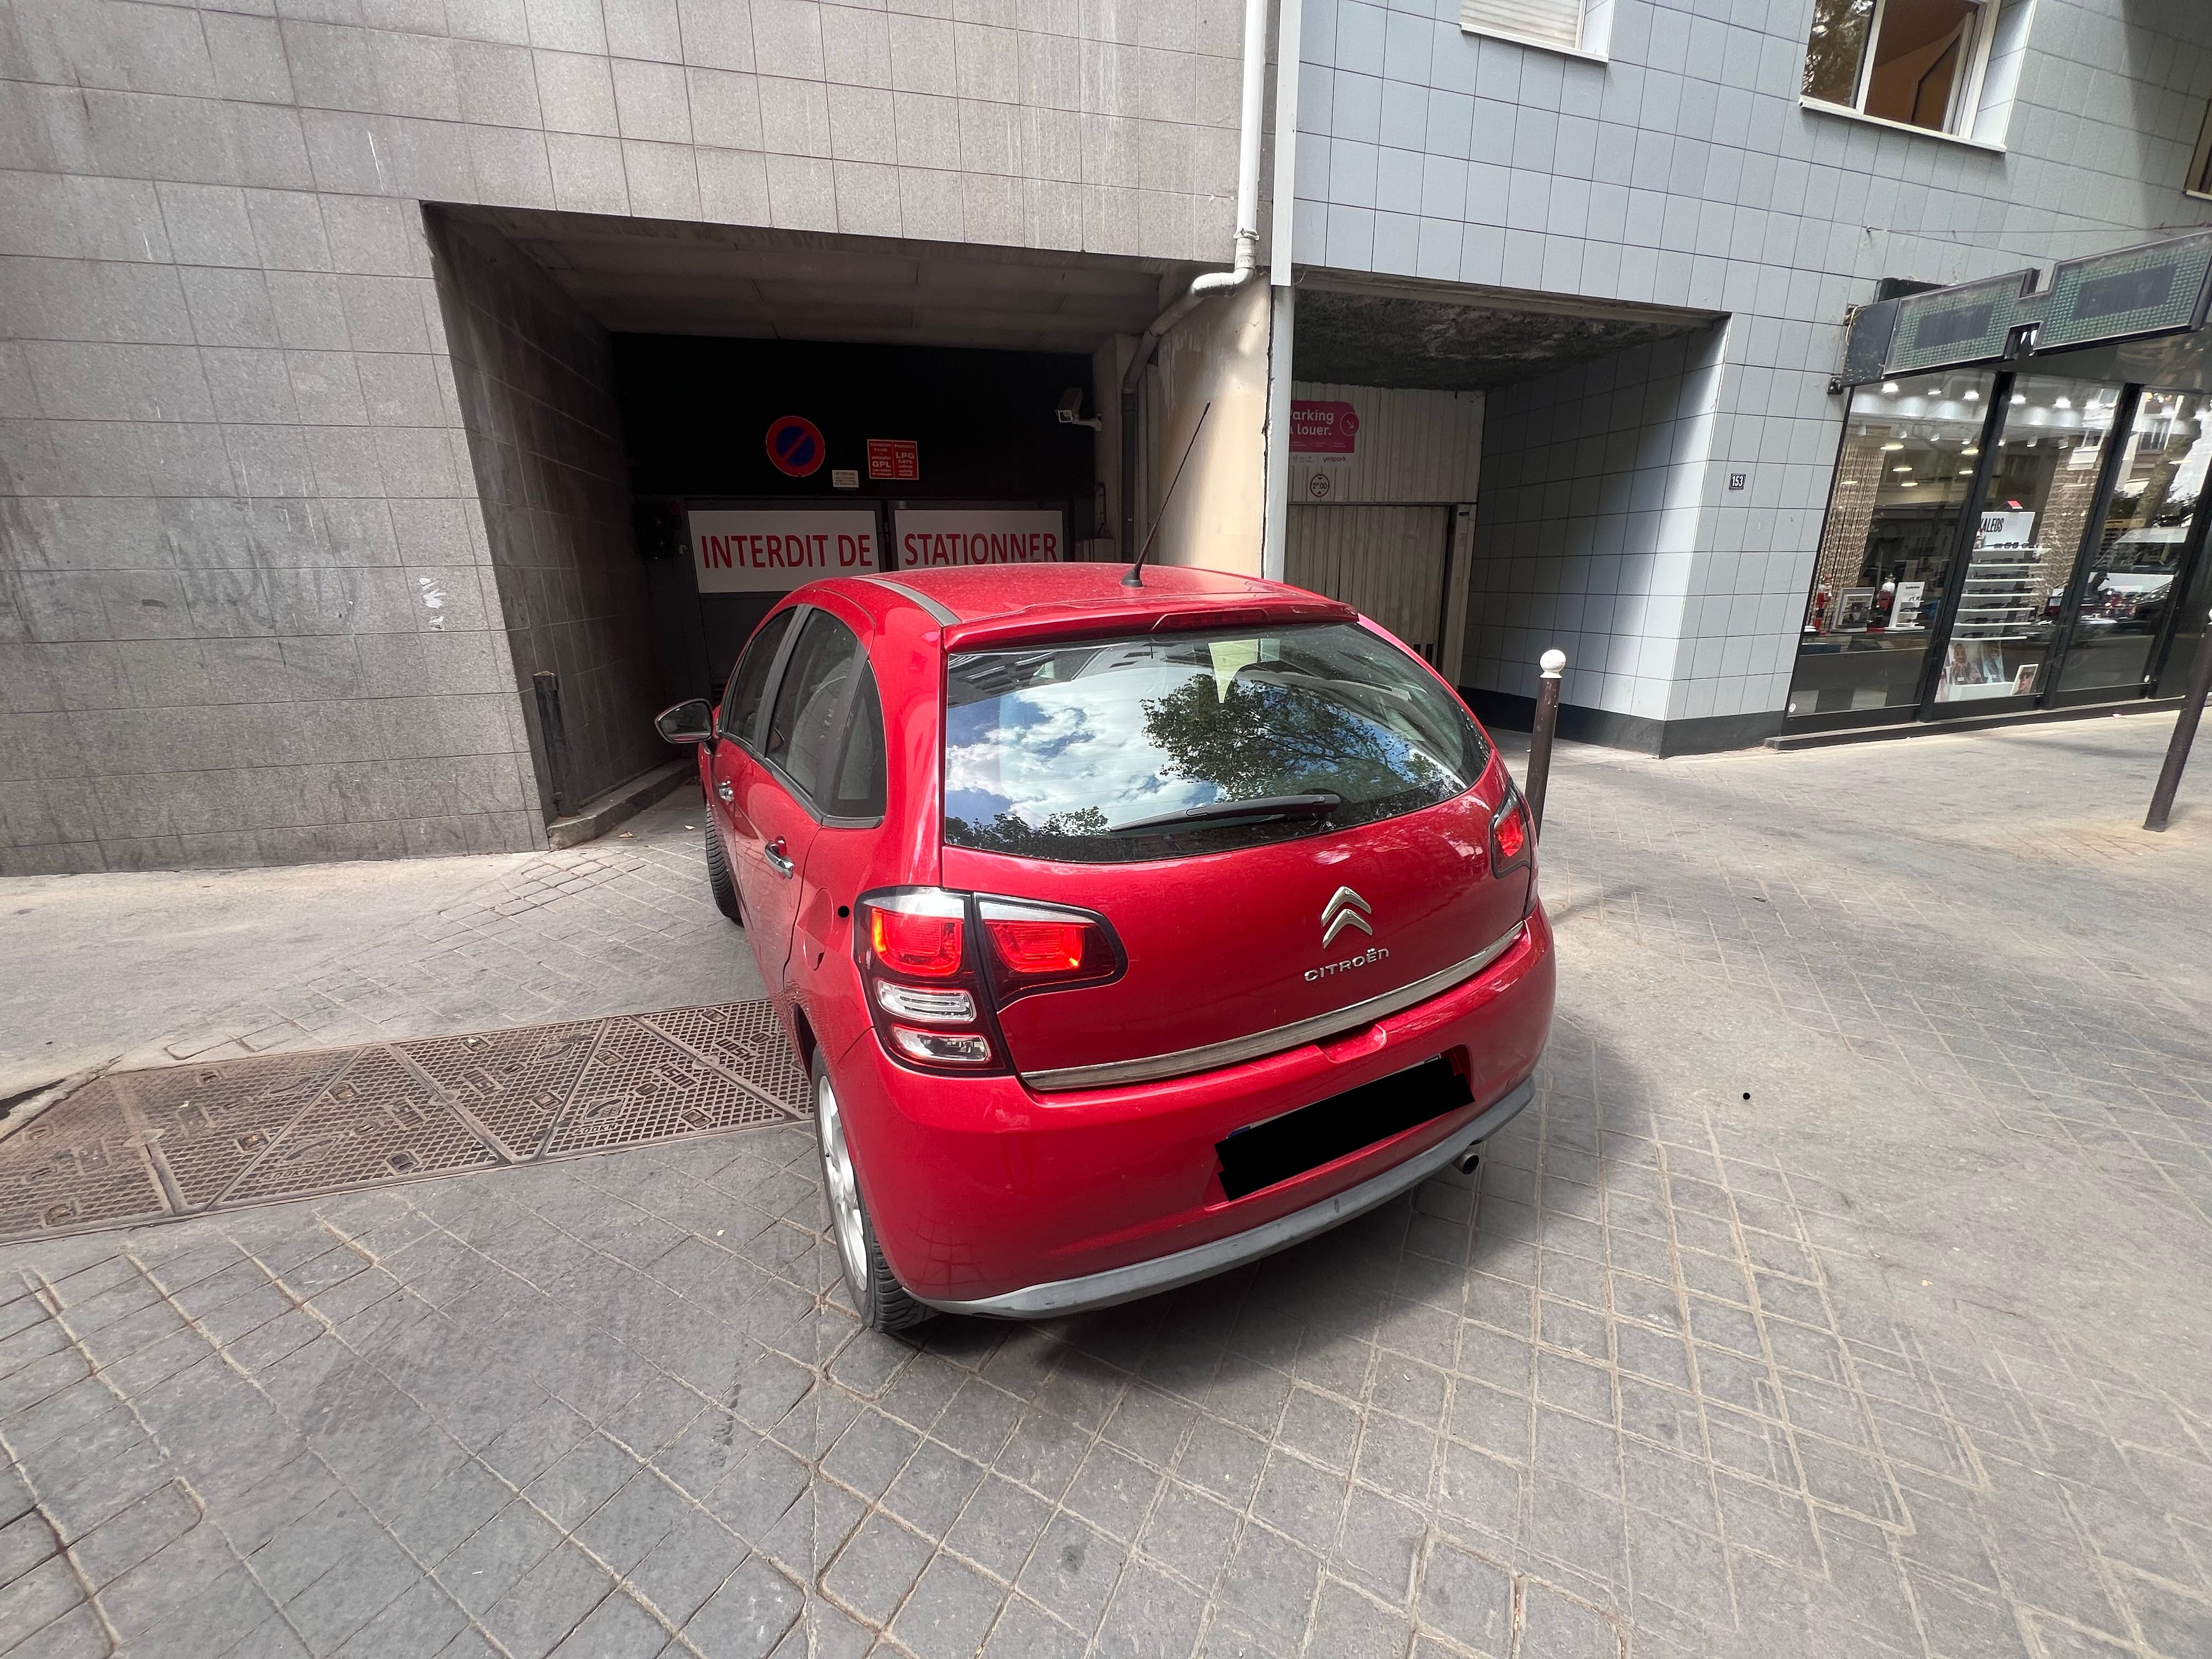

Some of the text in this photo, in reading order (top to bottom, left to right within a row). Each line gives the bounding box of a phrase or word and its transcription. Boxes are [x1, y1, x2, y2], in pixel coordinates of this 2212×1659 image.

[1290, 409, 1334, 425] arking
[1297, 423, 1332, 436] louer.
[1732, 475, 1743, 487] 153
[701, 534, 873, 568] INTERDIT DE
[904, 533, 1058, 566] STATIONNER
